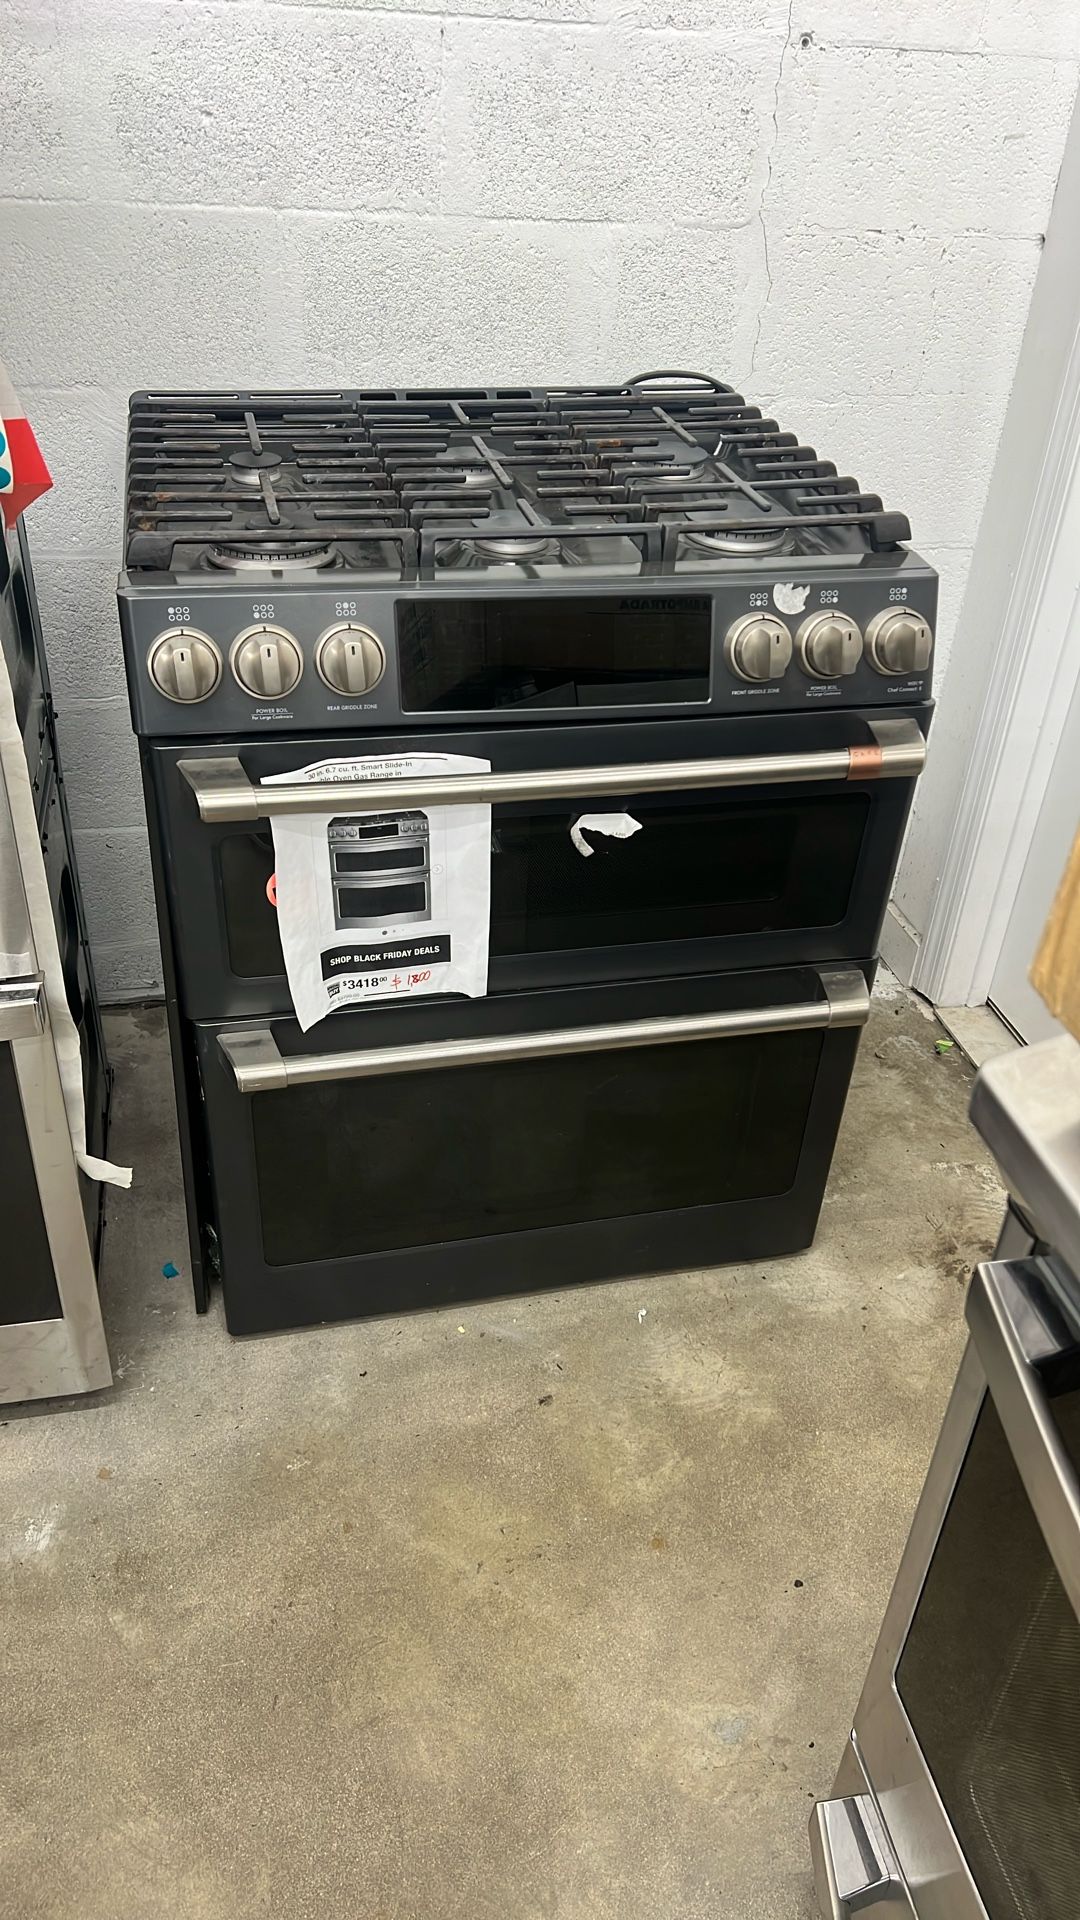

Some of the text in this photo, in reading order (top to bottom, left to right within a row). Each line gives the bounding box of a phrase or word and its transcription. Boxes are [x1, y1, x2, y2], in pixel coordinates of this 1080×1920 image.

[361, 763, 383, 771] Smart
[385, 760, 412, 769] Slide-In
[370, 771, 393, 779] Range
[330, 945, 440, 966] SHOP BLACK FRIDAY DEALS
